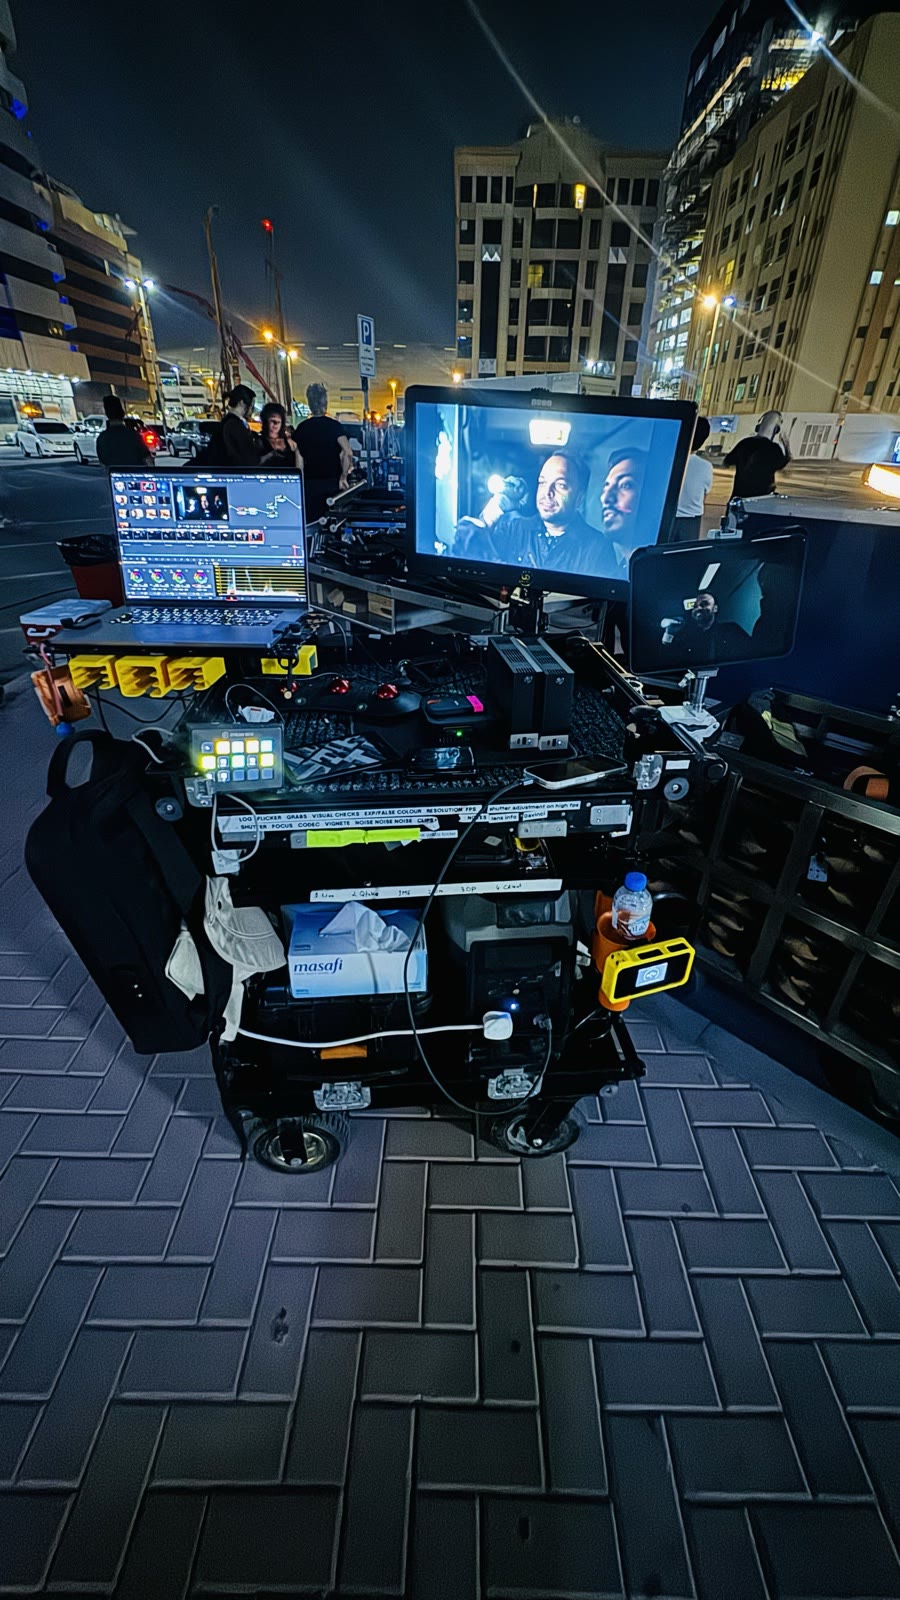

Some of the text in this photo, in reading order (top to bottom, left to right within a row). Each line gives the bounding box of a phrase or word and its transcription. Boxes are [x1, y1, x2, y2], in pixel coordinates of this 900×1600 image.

[363, 321, 370, 343] P
[426, 806, 463, 814] RESOLUTION
[512, 803, 546, 812] adjustment
[555, 801, 569, 809] high
[293, 957, 343, 974] masafi
